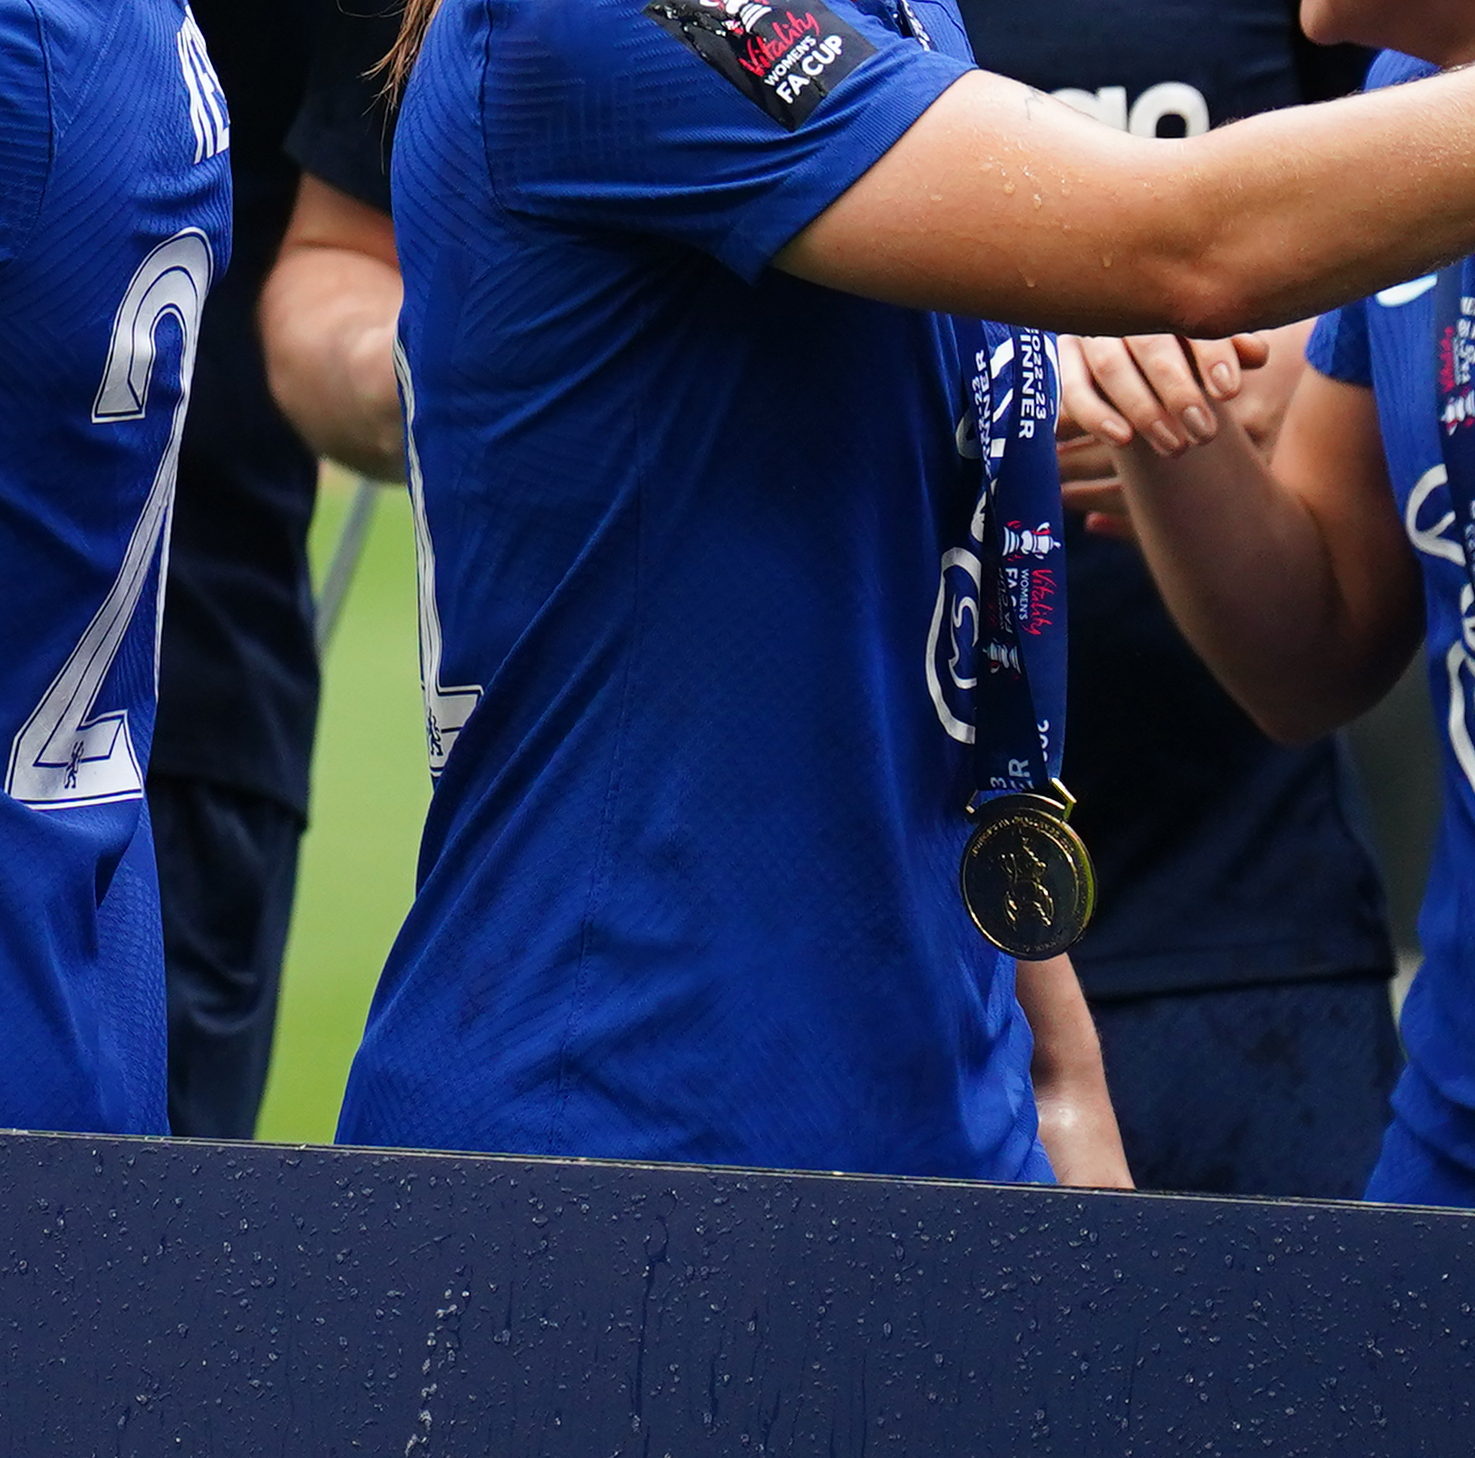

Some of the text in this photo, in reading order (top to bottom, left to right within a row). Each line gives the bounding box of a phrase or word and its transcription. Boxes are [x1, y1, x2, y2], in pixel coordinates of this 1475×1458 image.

[737, 10, 821, 78] Vitality
[763, 34, 818, 87] WOMEN'S
[775, 34, 844, 105] FA CUP
[1017, 327, 1036, 440] INNER
[4, 225, 215, 811] 2
[1004, 567, 1019, 589] FA
[1018, 568, 1030, 621] WOMEN'S
[1021, 568, 1059, 637] Vitality
